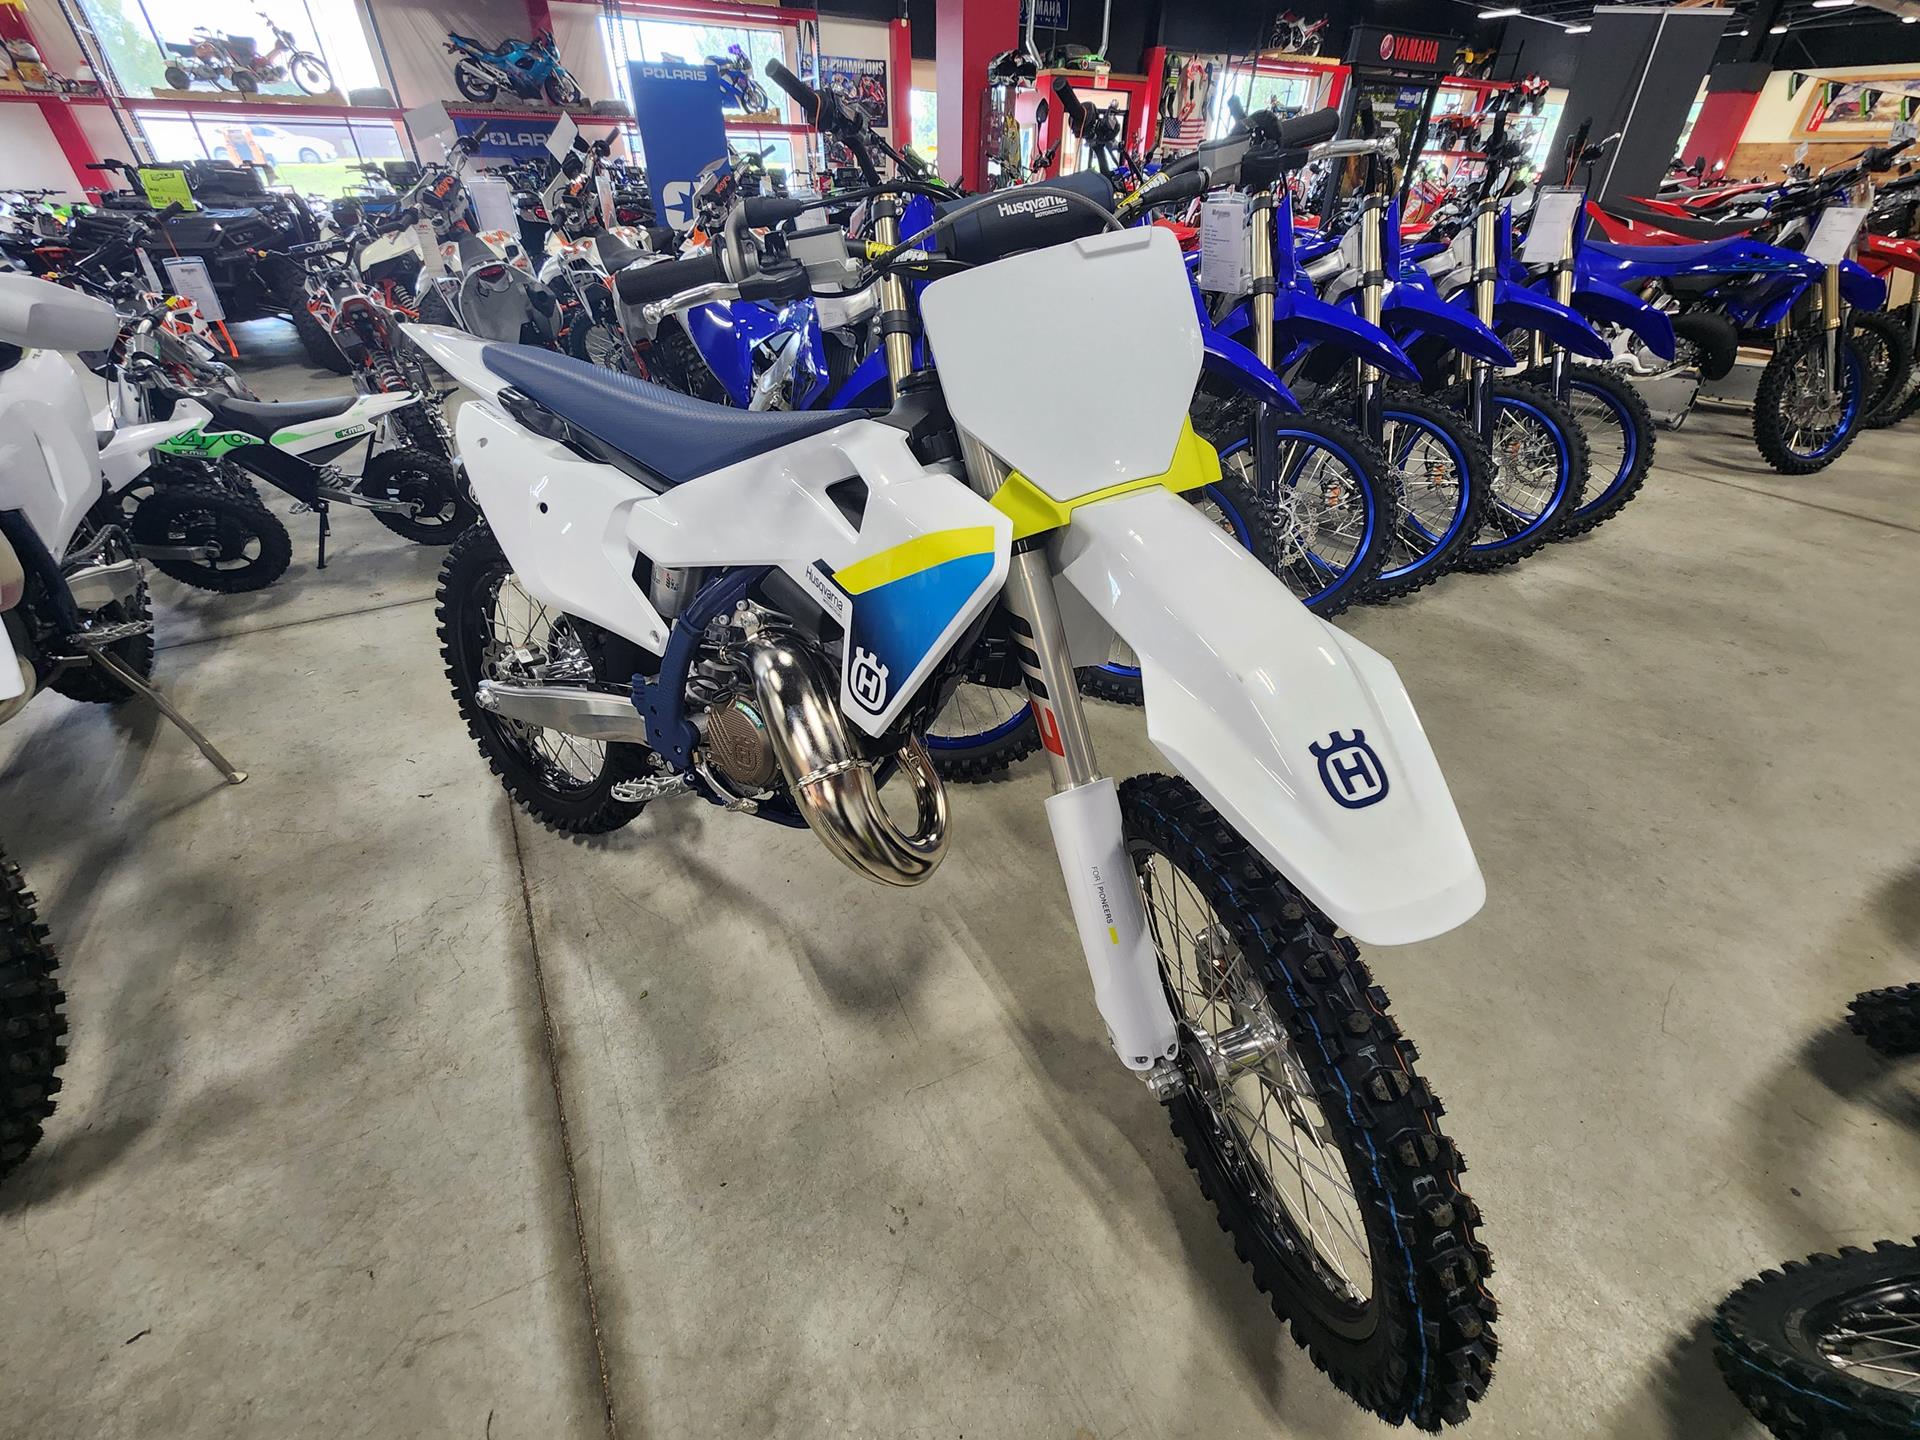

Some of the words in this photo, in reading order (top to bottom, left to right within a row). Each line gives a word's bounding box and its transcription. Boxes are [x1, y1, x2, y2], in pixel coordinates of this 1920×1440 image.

[1394, 36, 1439, 64] YAMAHA
[642, 67, 708, 82] POLARIS
[832, 59, 885, 76] CHAMPIONS
[1034, 206, 1069, 218] MOTORCYCLES
[805, 565, 844, 611] Husqvarna
[1091, 866, 1101, 882] FOR
[1097, 886, 1114, 924] PIONEERS
